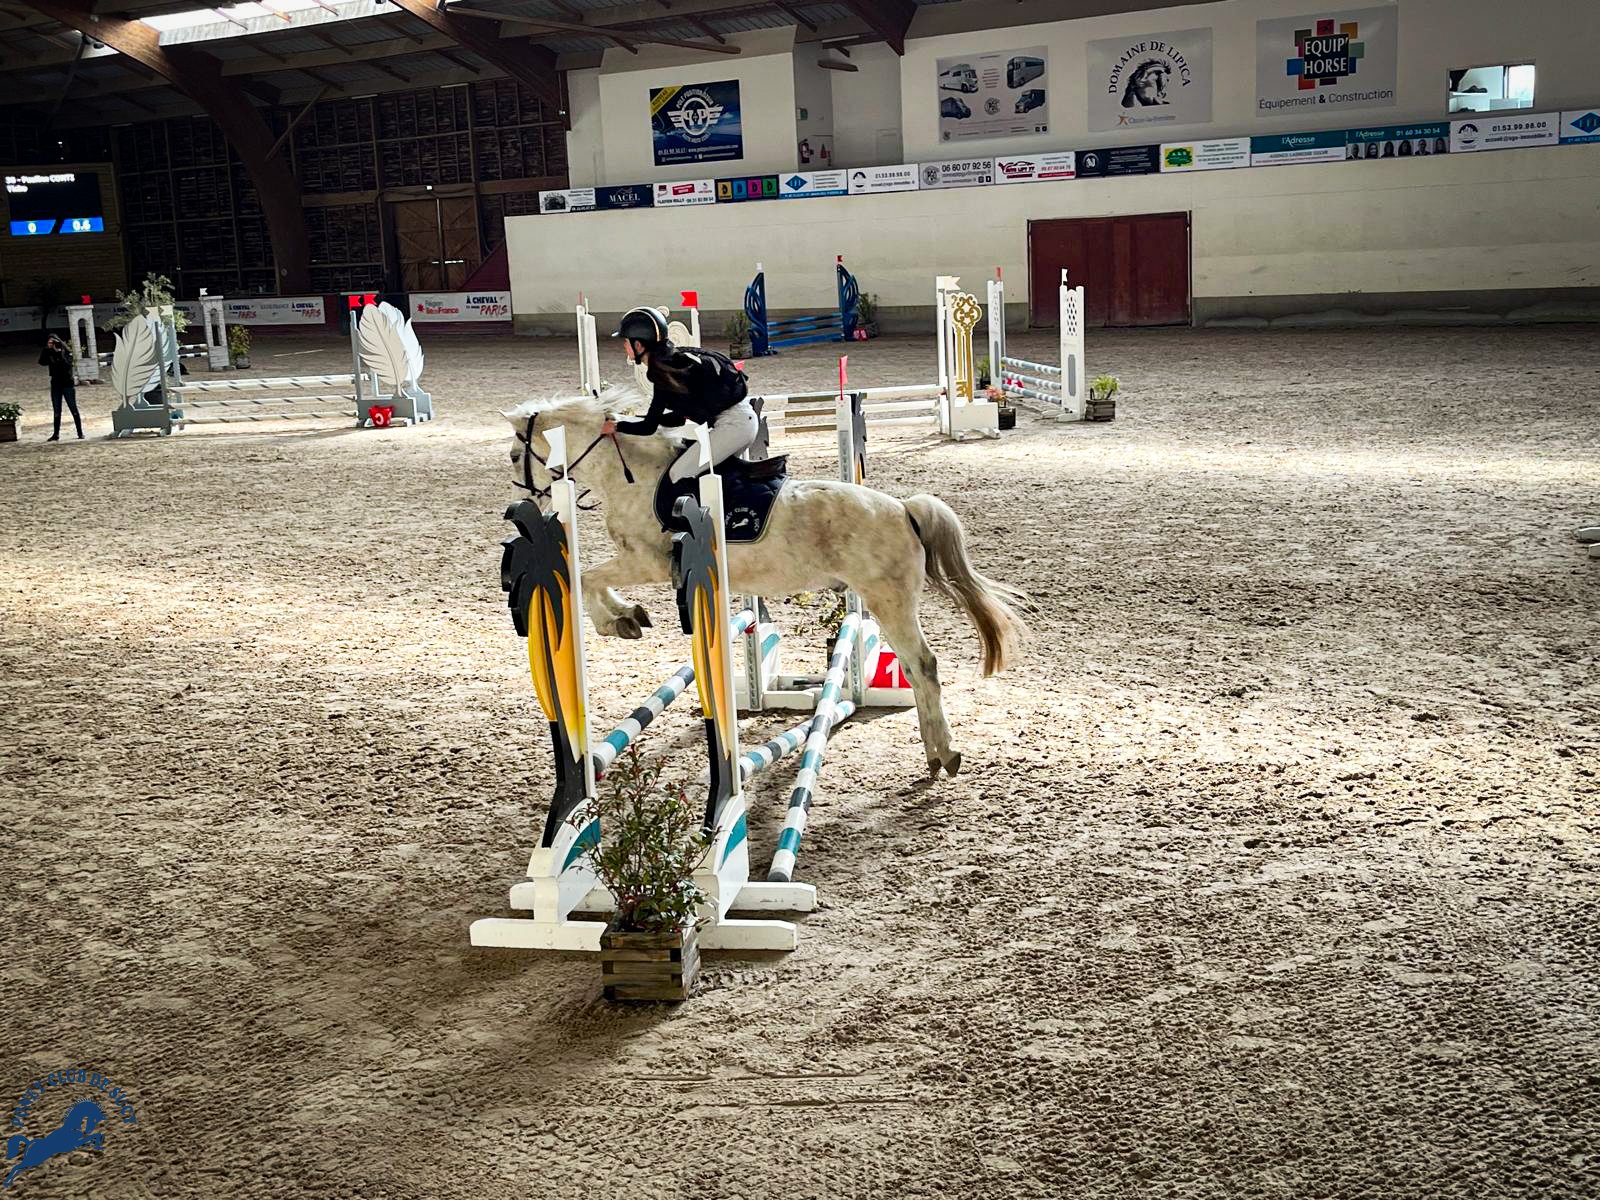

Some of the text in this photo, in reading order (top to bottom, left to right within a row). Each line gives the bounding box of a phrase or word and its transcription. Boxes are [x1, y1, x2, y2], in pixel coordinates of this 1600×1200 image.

[1305, 37, 1349, 57] EQUIP'
[1109, 40, 1191, 94] DOMAINE DE LIPICA
[1304, 57, 1347, 75] HORSE
[1318, 94, 1326, 104] &
[1328, 89, 1393, 104] Construction
[1281, 135, 1315, 146] l'Adresse
[1355, 130, 1385, 140] l'Adresse
[941, 161, 991, 172] 06 60 07 92 56
[28, 222, 37, 233] 0
[480, 304, 508, 316] PARIS
[886, 657, 899, 688] 1
